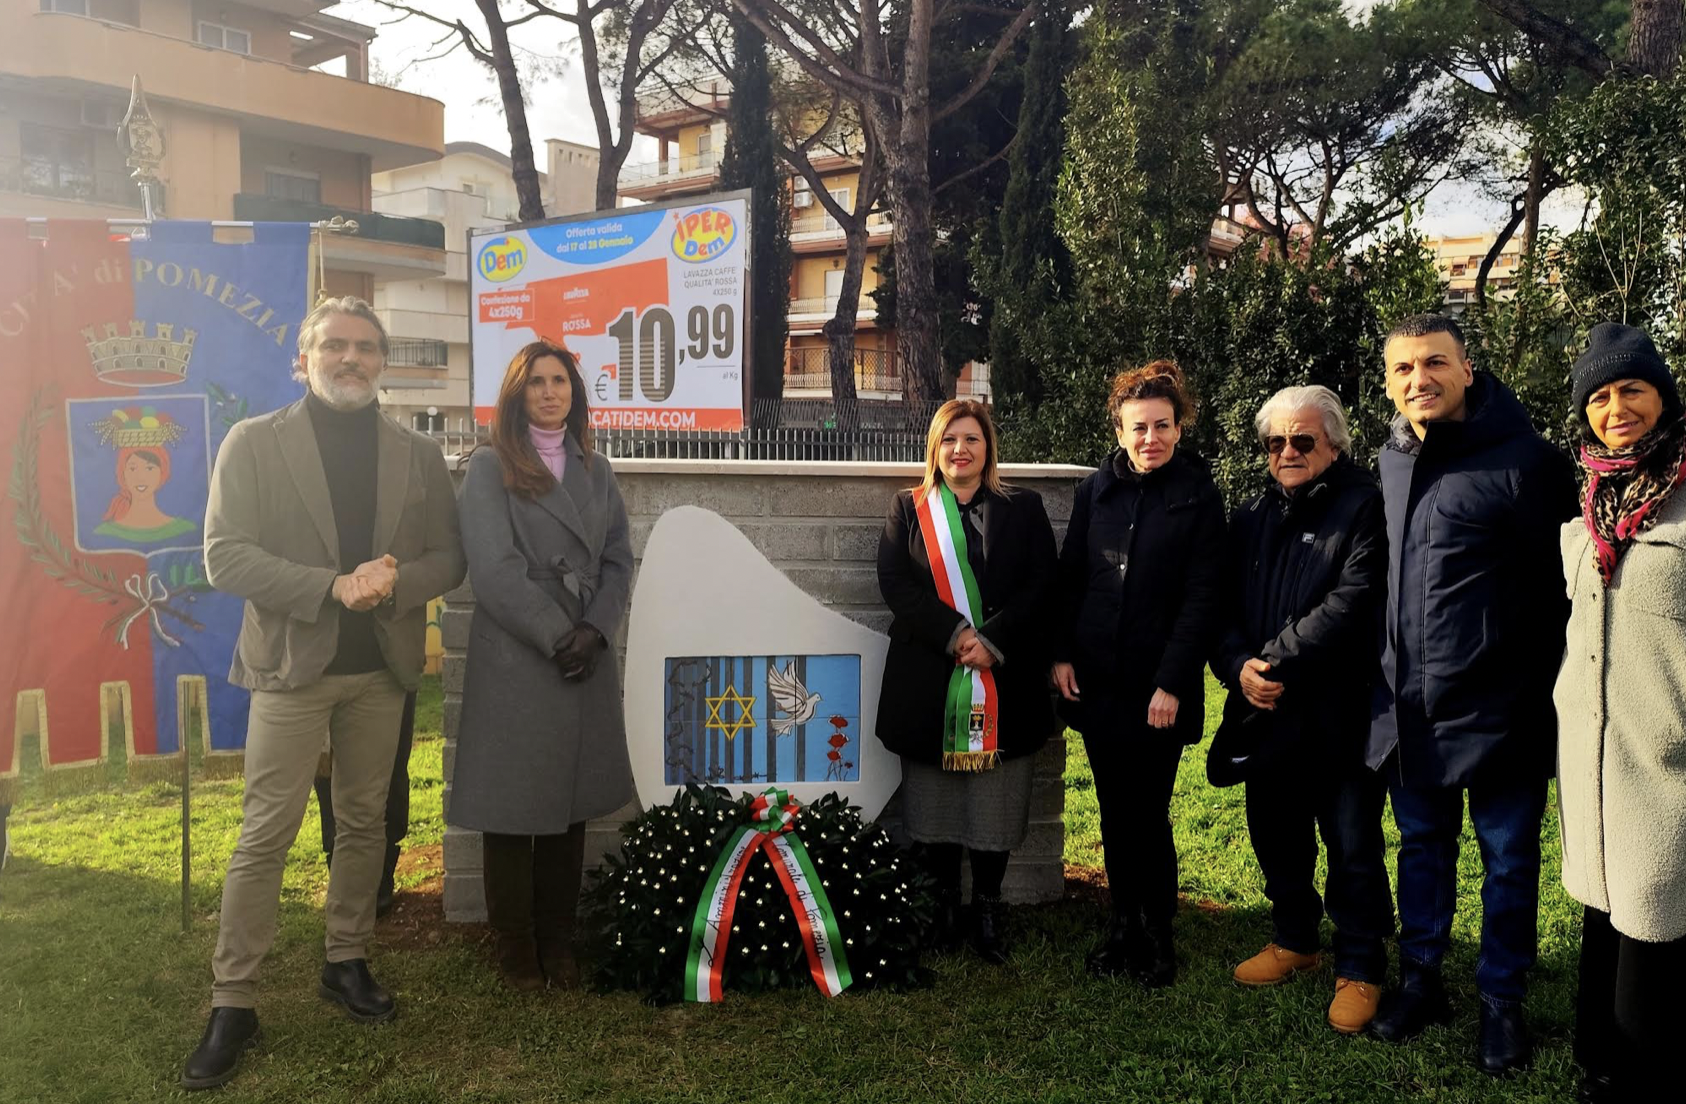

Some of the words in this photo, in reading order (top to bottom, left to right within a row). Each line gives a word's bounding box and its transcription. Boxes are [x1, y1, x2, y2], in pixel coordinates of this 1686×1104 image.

[566, 227, 596, 239] Offerta
[597, 222, 623, 235] valida
[556, 242, 570, 253] dal
[570, 241, 578, 252] 17
[579, 240, 587, 251] al
[684, 236, 726, 257] Dem
[484, 249, 524, 274] Dem
[683, 268, 713, 279] LAVAZZA
[714, 276, 737, 287] ROSSA
[94, 257, 124, 285] di
[134, 257, 289, 348] POMEZIA
[563, 318, 592, 333] ROSSA
[730, 371, 739, 381] Kg
[588, 409, 696, 428] CATIDEM.COM
